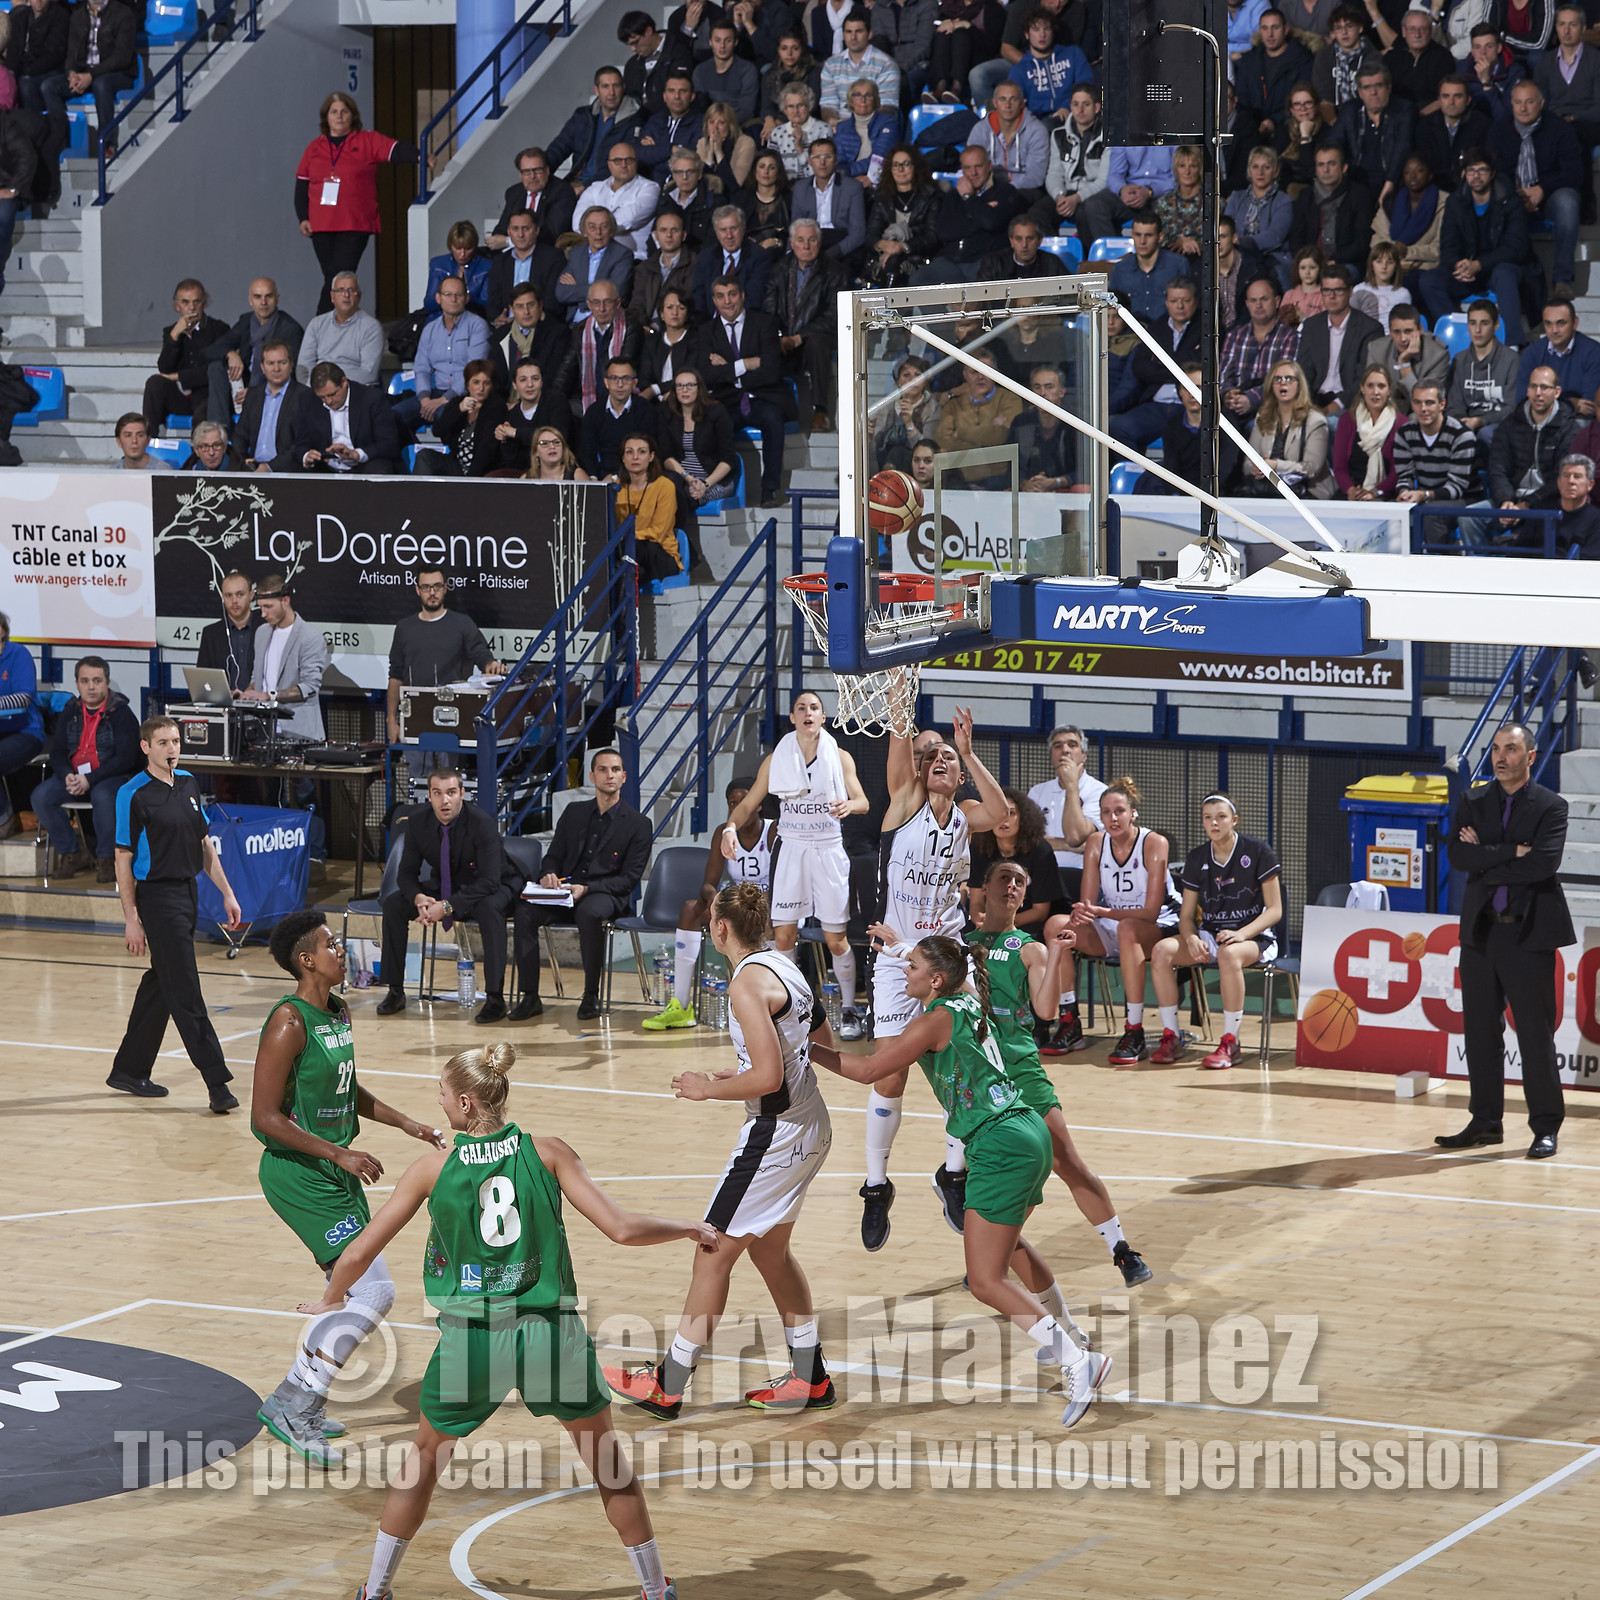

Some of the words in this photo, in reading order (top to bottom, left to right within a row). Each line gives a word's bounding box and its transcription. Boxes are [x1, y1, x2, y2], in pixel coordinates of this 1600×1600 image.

[12, 524, 46, 541] TNT
[51, 525, 98, 543] Canal
[103, 526, 126, 544] 30
[253, 512, 296, 562] La
[316, 513, 528, 569] Doréenne
[12, 546, 61, 566] câble
[66, 550, 86, 567] et
[92, 549, 127, 568] box
[14, 574, 128, 588] www.angers-tele.fr
[359, 569, 401, 586] Artisan
[479, 572, 529, 589] Pâtissier
[1053, 605, 1159, 630] MARTY
[173, 626, 190, 641] 42
[323, 631, 360, 647] GERS
[487, 636, 505, 652] 41
[514, 636, 534, 653] 87
[572, 639, 590, 655] 17
[993, 649, 1024, 670] 20
[1035, 651, 1063, 671] 17
[1069, 652, 1102, 673] 47
[1179, 659, 1392, 685] www.sohabitat.fr
[783, 802, 830, 814] ANGERS
[245, 827, 305, 855] molten
[928, 829, 954, 858] 12
[737, 856, 761, 877] 13
[904, 868, 958, 887] ANGER
[1112, 870, 1134, 893] 15
[895, 890, 932, 907] ESPACE
[1202, 910, 1228, 921] SPACE
[988, 948, 1010, 962] YŐR
[479, 1175, 521, 1247] 8
